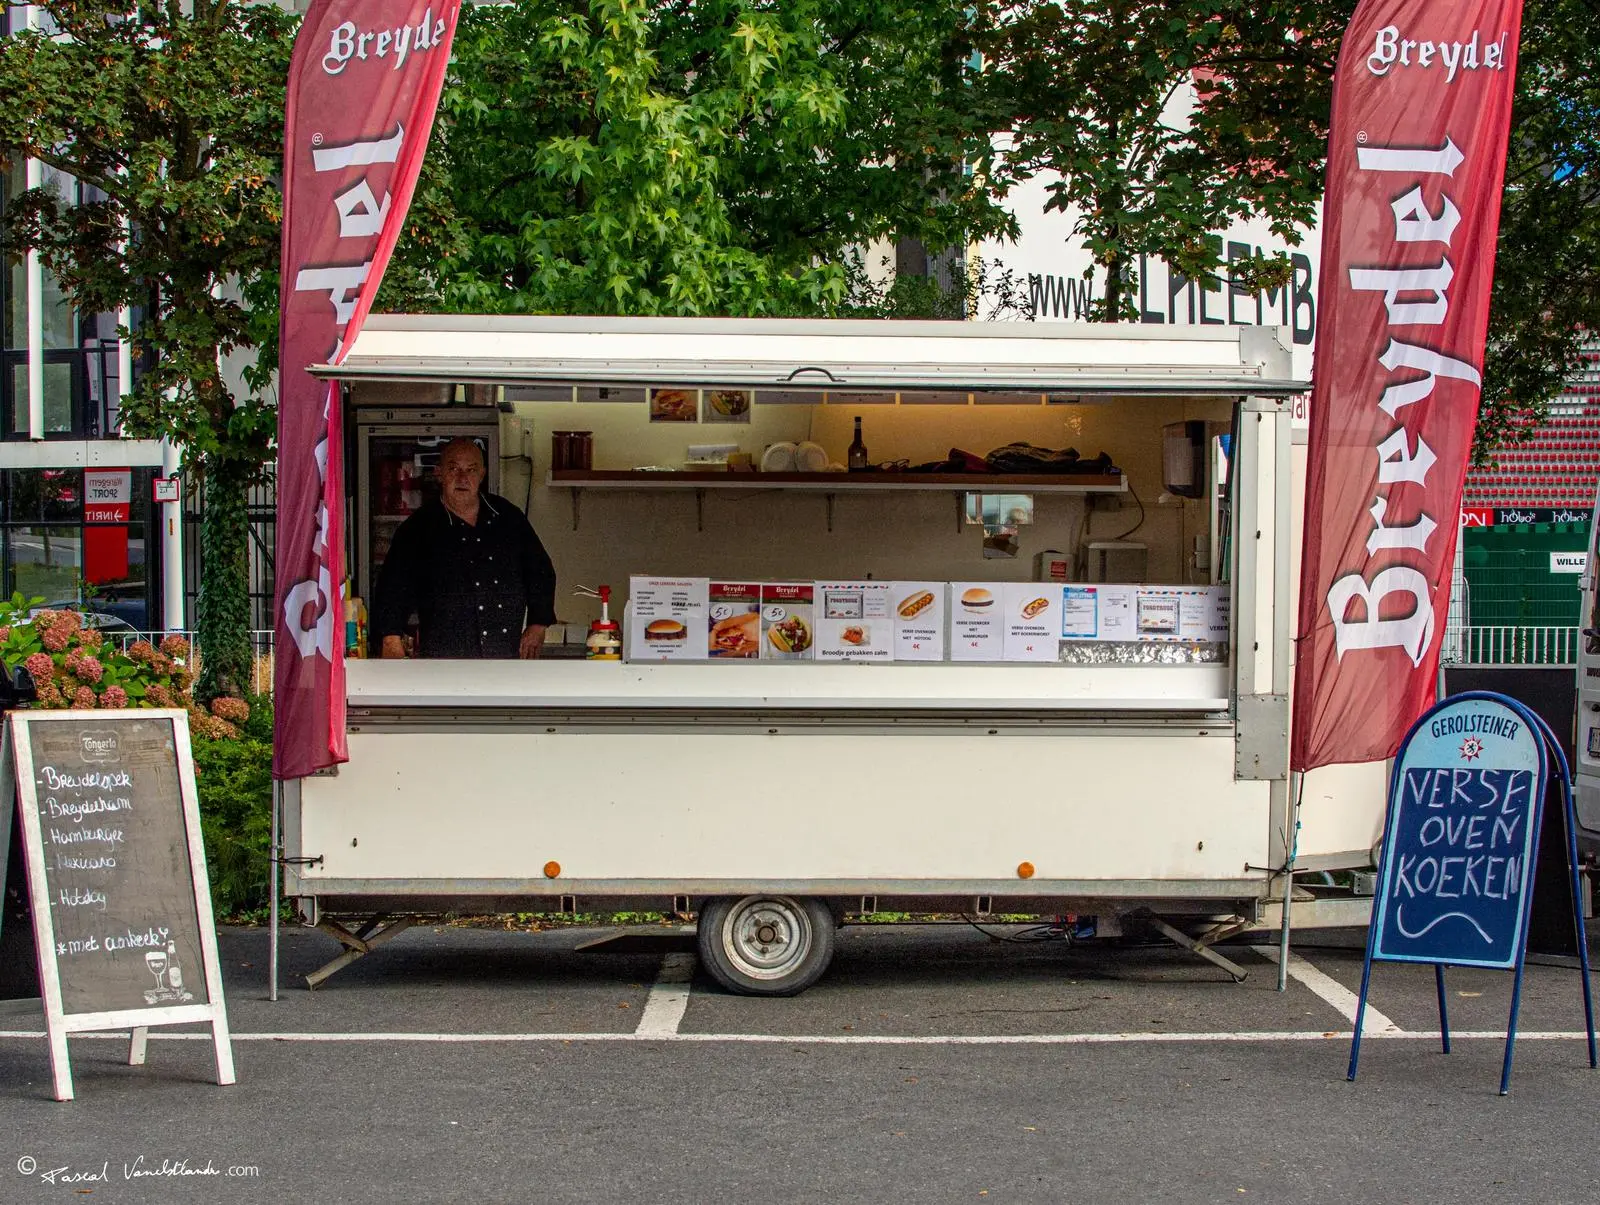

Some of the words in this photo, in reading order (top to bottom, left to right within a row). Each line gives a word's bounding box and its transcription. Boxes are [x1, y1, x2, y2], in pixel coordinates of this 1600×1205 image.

[1367, 25, 1507, 84] Breydel
[1327, 134, 1481, 669] Breydel
[1557, 558, 1586, 566] WILLE
[83, 738, 117, 752] Tongerlo
[1431, 714, 1519, 740] GEROLSTEINER
[1408, 769, 1526, 814] VERSE
[1419, 815, 1520, 849] OVEN
[1393, 852, 1524, 900] KOEKEN
